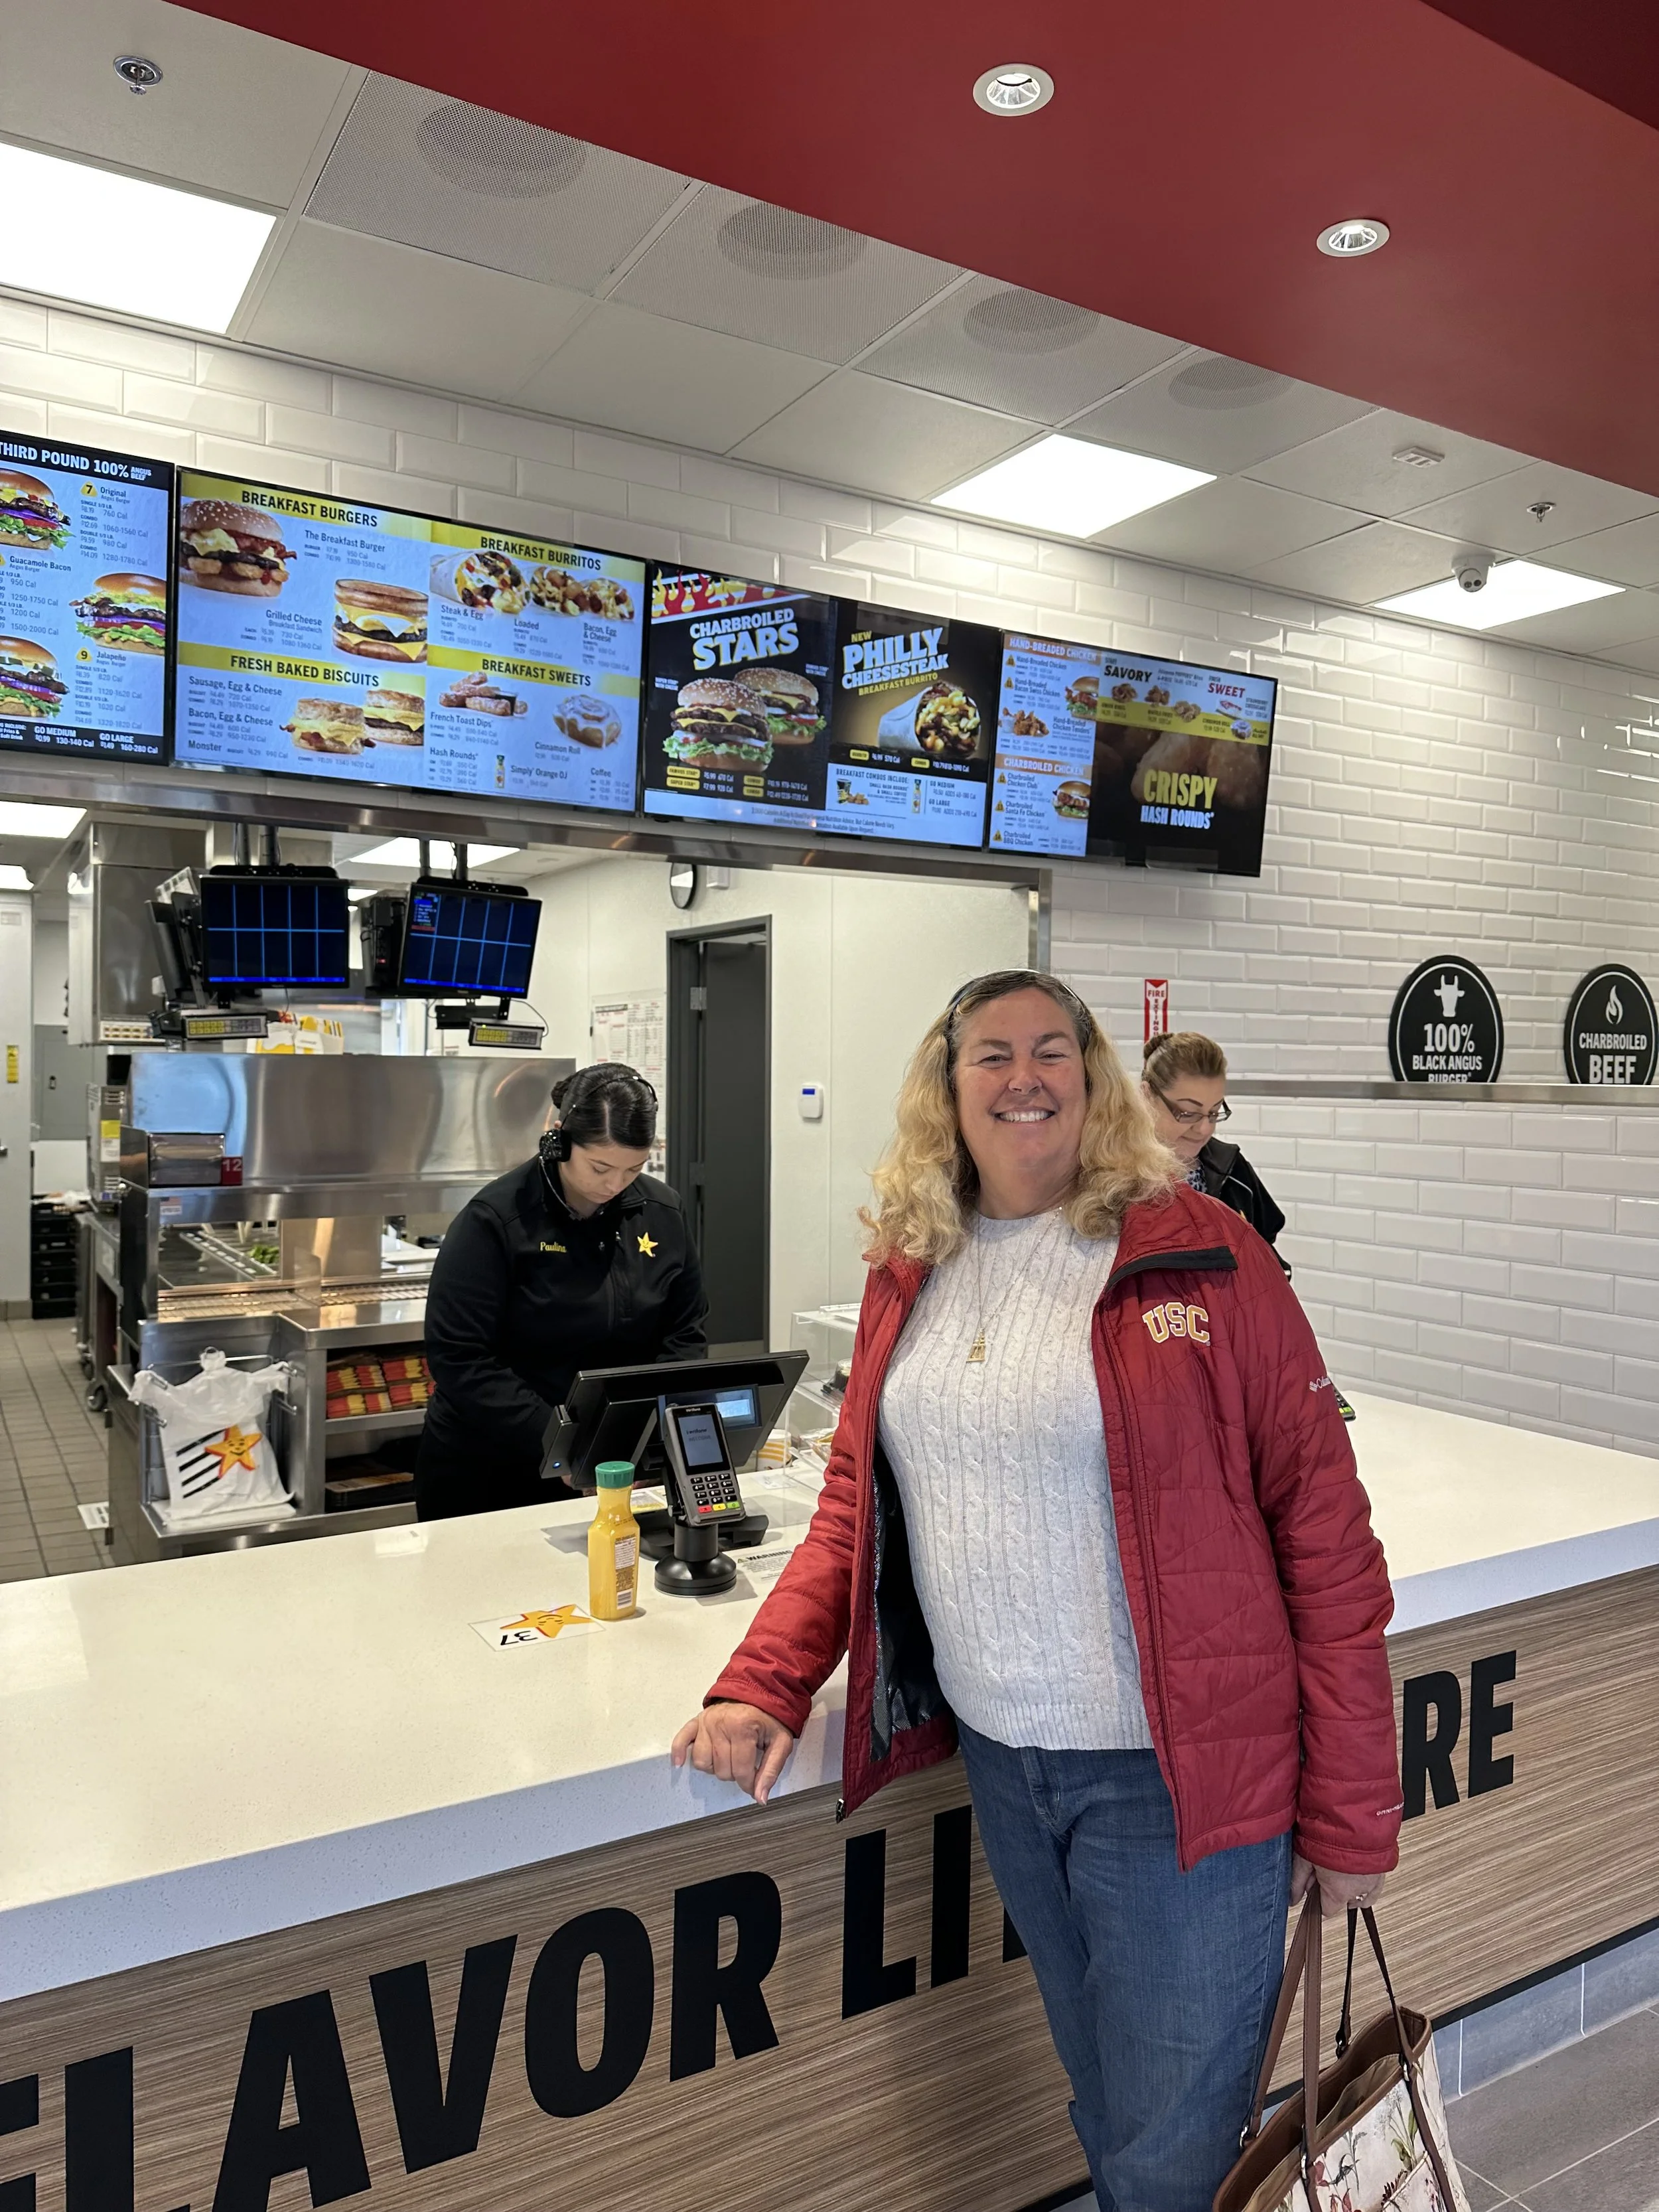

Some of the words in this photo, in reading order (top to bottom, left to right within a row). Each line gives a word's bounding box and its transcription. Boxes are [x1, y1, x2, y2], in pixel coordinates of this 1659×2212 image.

[41, 449, 90, 470] POUND
[94, 460, 129, 478] 100%
[131, 466, 151, 477] ANGUS
[131, 472, 146, 480] BEEF
[86, 484, 93, 494] 7
[100, 486, 126, 497] Original
[242, 490, 317, 516] BREAKFAST
[320, 505, 378, 527] BURGERS
[305, 530, 319, 540] The
[321, 533, 358, 548] Breakfast
[360, 540, 386, 552] Burger
[481, 537, 546, 559] BREAKFAST
[548, 550, 601, 570] BURRITOS
[10, 555, 48, 568] Guacamole
[50, 561, 71, 571] Bacon
[11, 578, 23, 587] 950
[11, 593, 46, 604] 1250-1750
[11, 608, 27, 617] 1200
[266, 609, 292, 621] Grilled
[294, 614, 322, 625] Cheese
[441, 605, 461, 615] Steak
[463, 609, 469, 617] &
[470, 611, 483, 621] Egg
[11, 623, 46, 634] 1500-2000
[514, 619, 540, 630] Loaded
[689, 608, 795, 638] CHARBROILED
[851, 630, 872, 643] NEW
[81, 650, 88, 659] 9
[692, 623, 799, 671] STARS
[842, 627, 943, 674] PHILLY
[1009, 637, 1066, 656] HAND-BREADED
[1066, 648, 1098, 662] CHICKEN
[96, 651, 126, 661] Jalapeño
[1016, 656, 1048, 668] Hand-Breaded
[1049, 661, 1067, 670] Chicken
[231, 655, 272, 672] FRESH
[277, 662, 319, 678] BAKED
[323, 670, 380, 687] BISCUITS
[482, 659, 546, 680] BREAKFAST
[549, 670, 591, 686] SWEETS
[841, 654, 949, 690] CHEESESTEAK
[1104, 665, 1152, 683] SAVORY
[188, 676, 226, 690] Sausage,
[228, 681, 243, 692] Egg
[245, 683, 251, 692] &
[253, 684, 282, 696] Cheese
[858, 679, 904, 696] BREAKFAST
[904, 672, 938, 686] BURRITO
[1208, 682, 1246, 698] SWEET
[188, 707, 216, 720] Bacon,
[219, 711, 234, 722] Egg
[236, 713, 242, 722] &
[244, 715, 273, 725] Cheese
[431, 711, 455, 723] French
[456, 715, 475, 725] Toast
[46, 727, 76, 737] MEDIUM
[100, 733, 111, 741] GO
[111, 734, 134, 743] LARGE
[188, 740, 222, 751] Monster
[430, 747, 448, 757] Hash
[535, 741, 567, 753] Cinnamon
[591, 767, 611, 777] Coffee
[1004, 757, 1052, 772] CHARBROILED
[1054, 764, 1084, 775] CHICKEN
[536, 769, 558, 779] Orange
[559, 771, 567, 779] OJ
[836, 768, 865, 778] BREAKFAST
[866, 773, 887, 782] COMBOS
[1007, 773, 1035, 782] Charbroiled
[1007, 780, 1026, 788] Chicken
[1143, 769, 1218, 809] CRISPY
[1005, 800, 1033, 810] Charbroiled
[1140, 805, 1169, 825] HASH
[1003, 830, 1031, 840] Charbroiled
[1423, 1023, 1475, 1054] 100%
[1579, 1032, 1648, 1051] CHARBROILED
[1412, 1055, 1447, 1070] BLACK
[1448, 1056, 1482, 1071] ANGUS
[1589, 1054, 1636, 1084] BEEF
[222, 1158, 242, 1171] 12
[1141, 1301, 1210, 1344] USC
[500, 1630, 538, 1645] 37
[1402, 1650, 1516, 1822] RE
